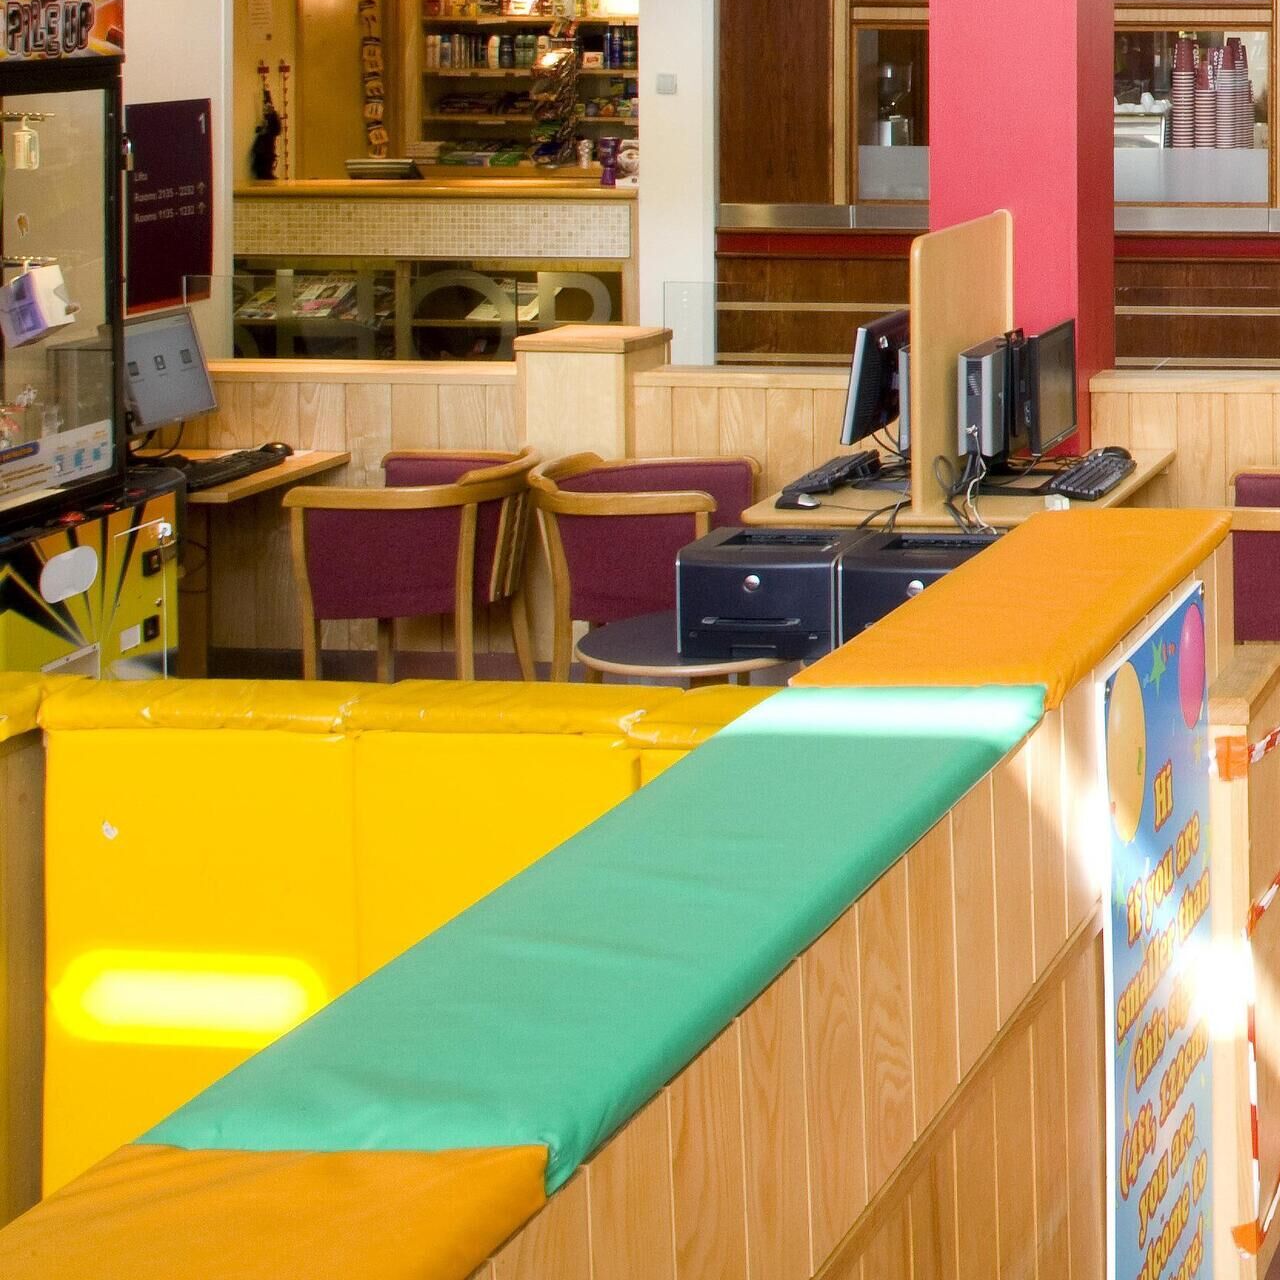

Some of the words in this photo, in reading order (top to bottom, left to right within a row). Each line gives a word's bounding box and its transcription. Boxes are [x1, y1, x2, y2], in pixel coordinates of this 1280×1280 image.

[198, 113, 205, 134] 1
[134, 213, 157, 223] Rooms
[1154, 758, 1174, 833] Hi
[1126, 877, 1143, 948] if
[1145, 846, 1175, 934] you
[1176, 809, 1200, 879] are
[1116, 919, 1176, 1046] smaller
[1177, 866, 1211, 946] than
[1134, 1007, 1167, 1095] this
[1138, 1149, 1169, 1250] you
[1170, 1102, 1196, 1179] are
[1192, 1148, 1208, 1208] to
